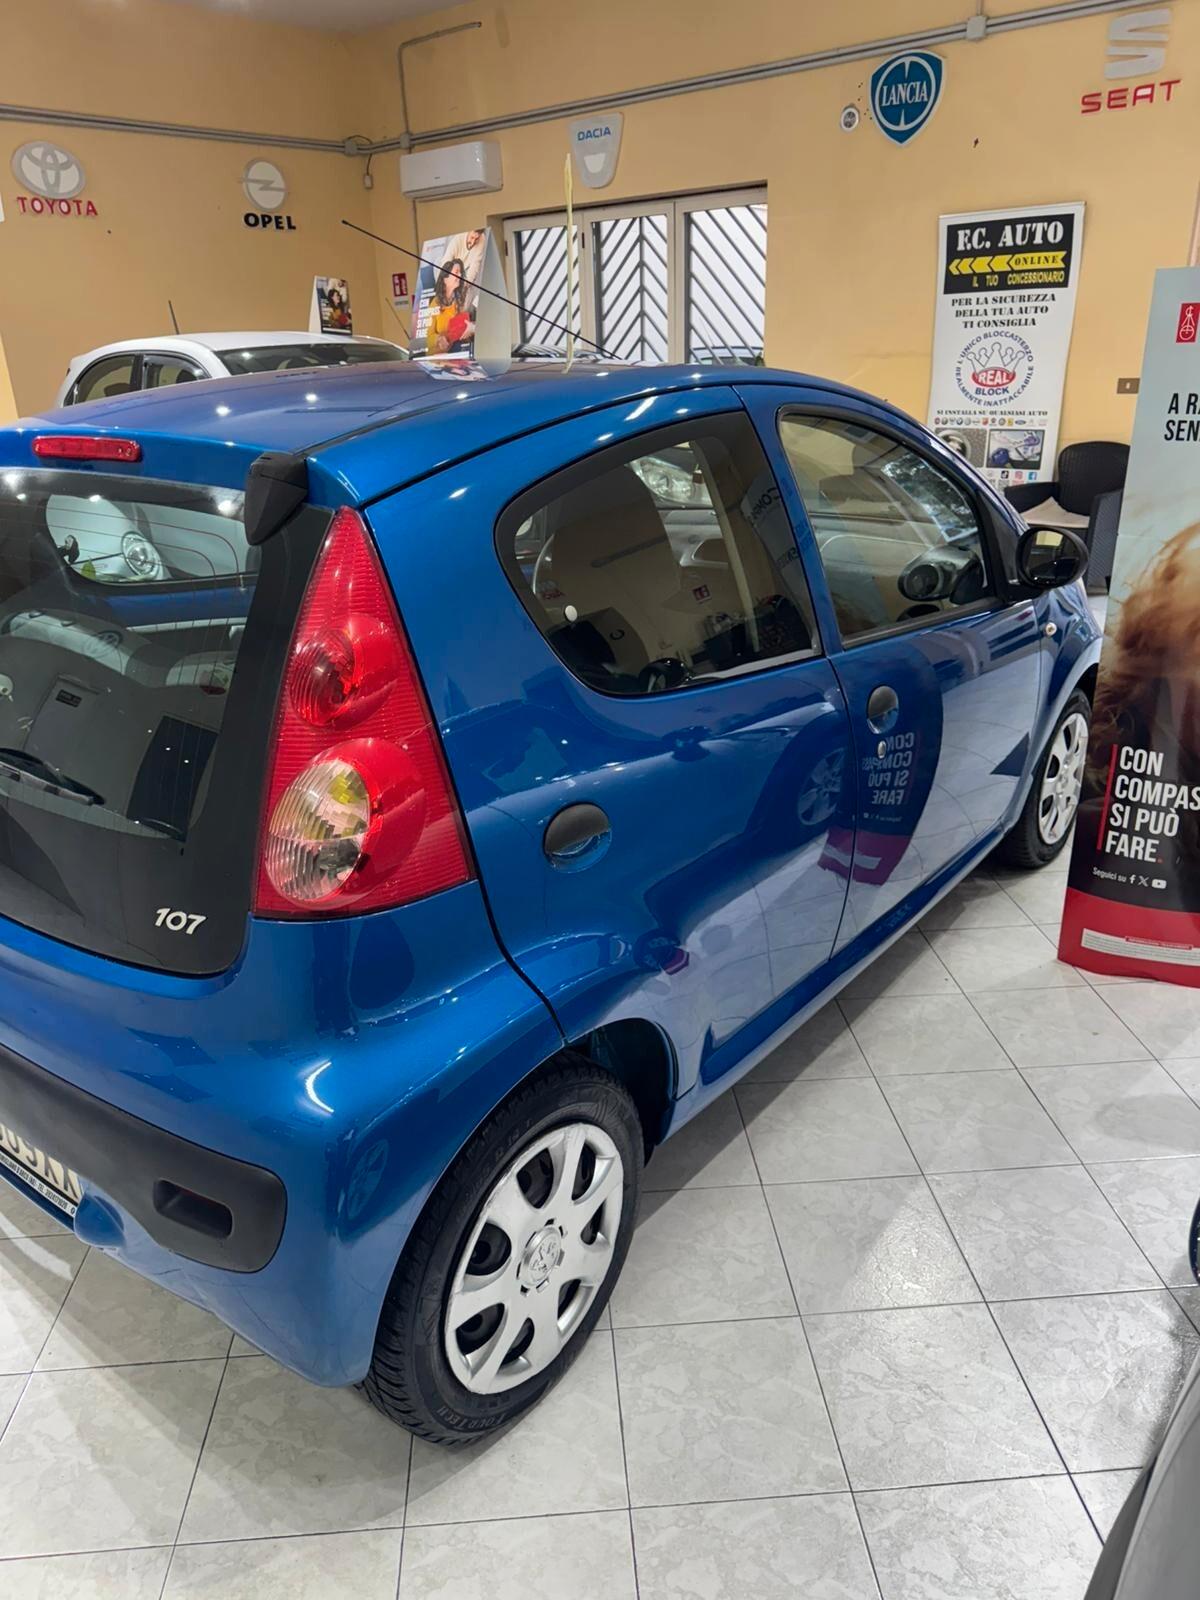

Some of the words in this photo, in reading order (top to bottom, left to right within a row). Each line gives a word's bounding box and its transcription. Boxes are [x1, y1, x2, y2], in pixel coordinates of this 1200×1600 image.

[882, 81, 928, 106] LANCIA
[1081, 79, 1181, 114] SEAT
[577, 127, 611, 141] DACIA
[17, 197, 98, 216] TOYOTA
[243, 213, 296, 230] OPEL
[957, 227, 991, 251] F.C.
[998, 221, 1064, 247] AUTO
[1014, 255, 1059, 266] ONLINE
[986, 274, 998, 286] TUO
[1007, 271, 1065, 285] CONCESSIONARIO
[952, 297, 972, 306] PER
[975, 296, 989, 305] LA
[991, 293, 1056, 305] SICUREZZA
[955, 308, 988, 317] DELLA
[991, 307, 1014, 316] TUA
[1017, 305, 1049, 315] AUTO
[962, 320, 974, 329] TI
[977, 318, 1036, 329] CONSIGLIA
[983, 330, 1034, 362] BLOCCASTERZO
[978, 370, 1010, 385] REAL
[975, 387, 1010, 396] BLOCK
[1168, 393, 1179, 415] A
[1186, 393, 1200, 415] R
[1164, 419, 1200, 442] SEN
[1120, 745, 1164, 777] CON
[1109, 803, 1131, 829] SI
[1134, 807, 1180, 837] PUÒ
[1093, 866, 1117, 880] Seguici
[155, 908, 206, 935] 107
